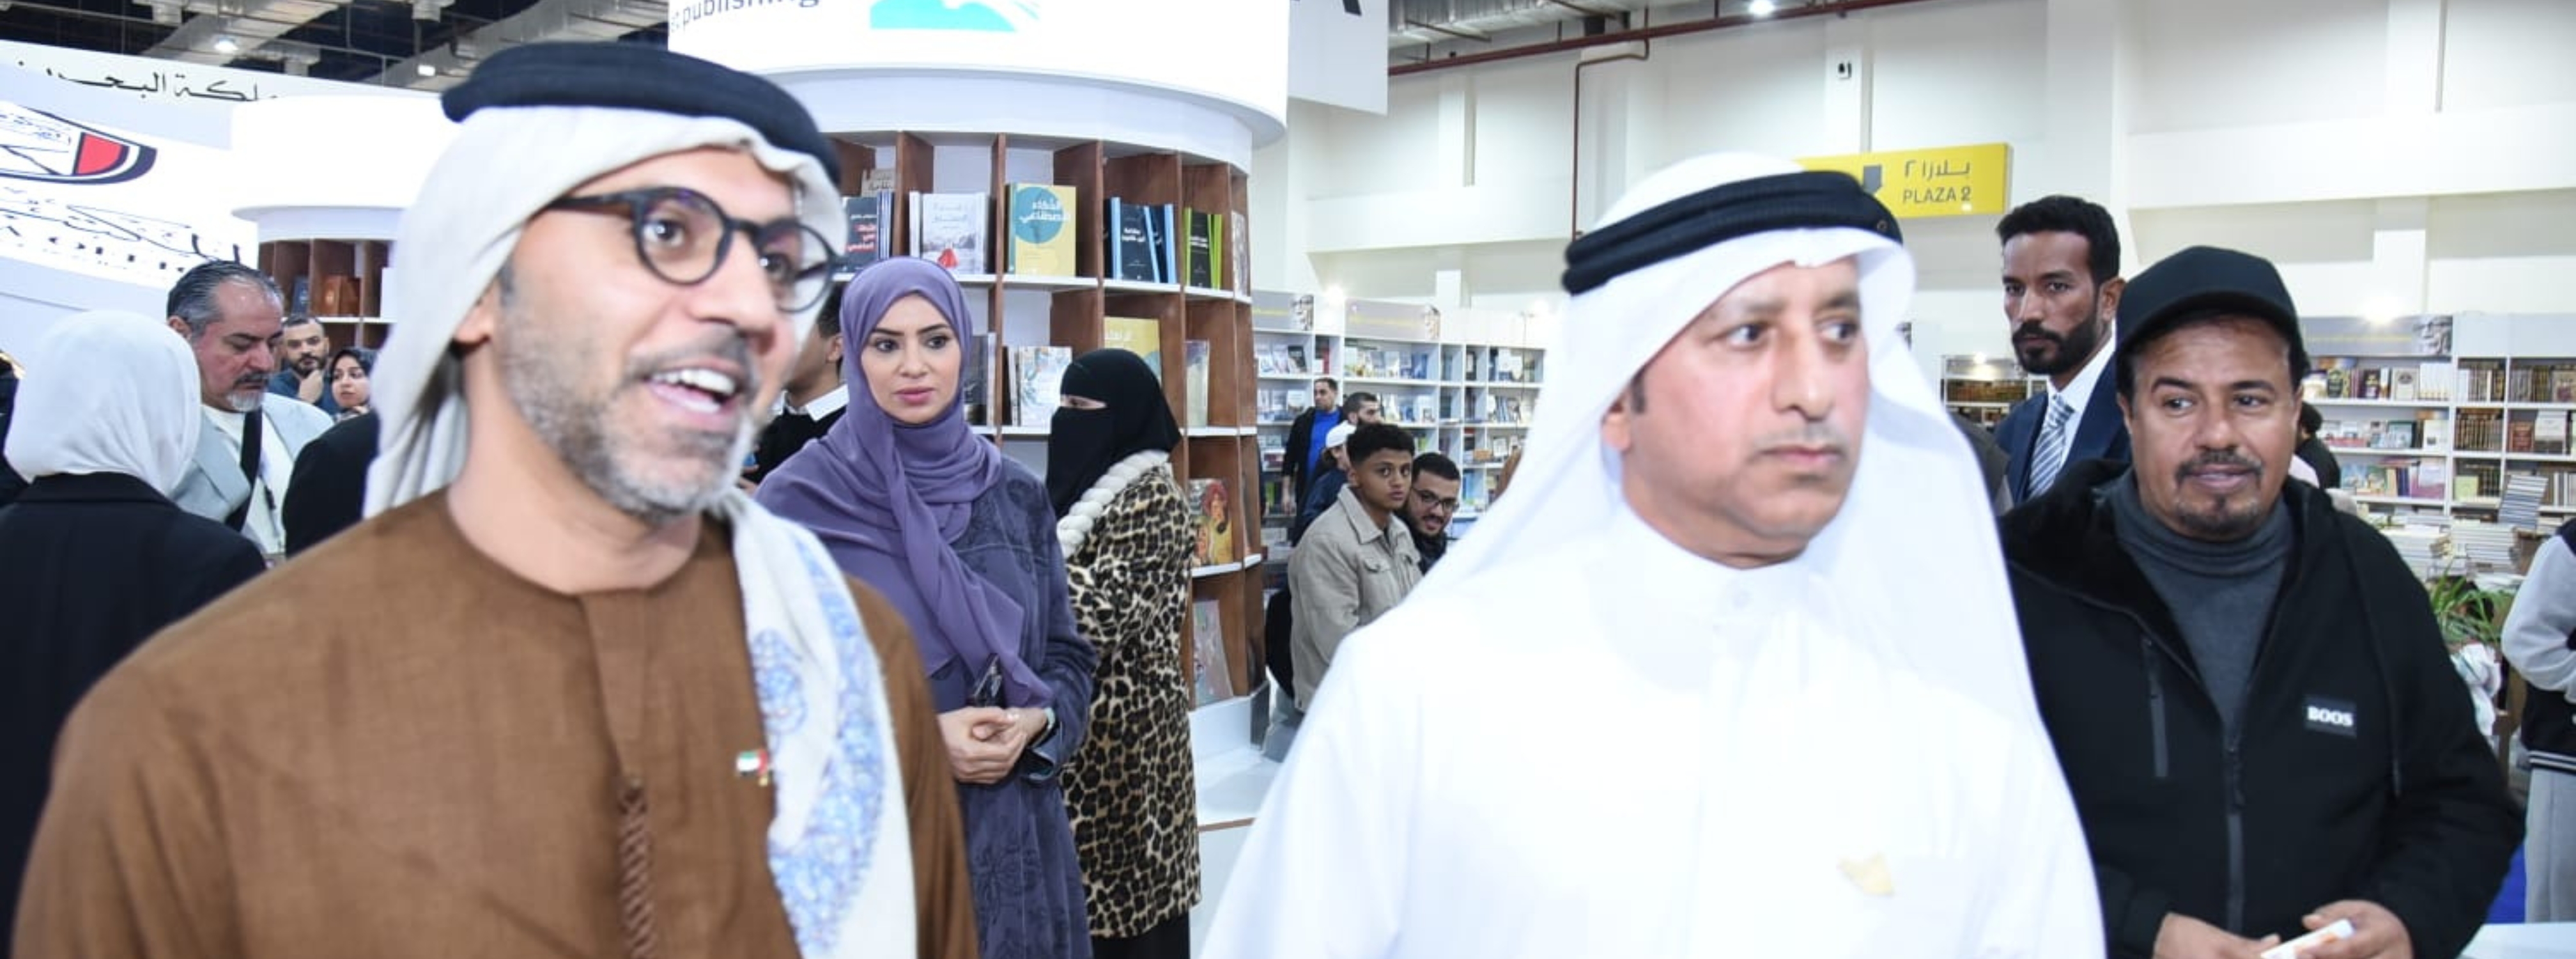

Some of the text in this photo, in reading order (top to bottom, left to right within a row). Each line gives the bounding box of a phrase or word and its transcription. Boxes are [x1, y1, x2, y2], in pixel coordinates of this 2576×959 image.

[683, 0, 820, 30] publis
[174, 72, 277, 102] لكة
[1922, 159, 1970, 181] بلازا
[1902, 185, 1971, 203] PLAZA 2
[2308, 706, 2354, 727] BOOS
